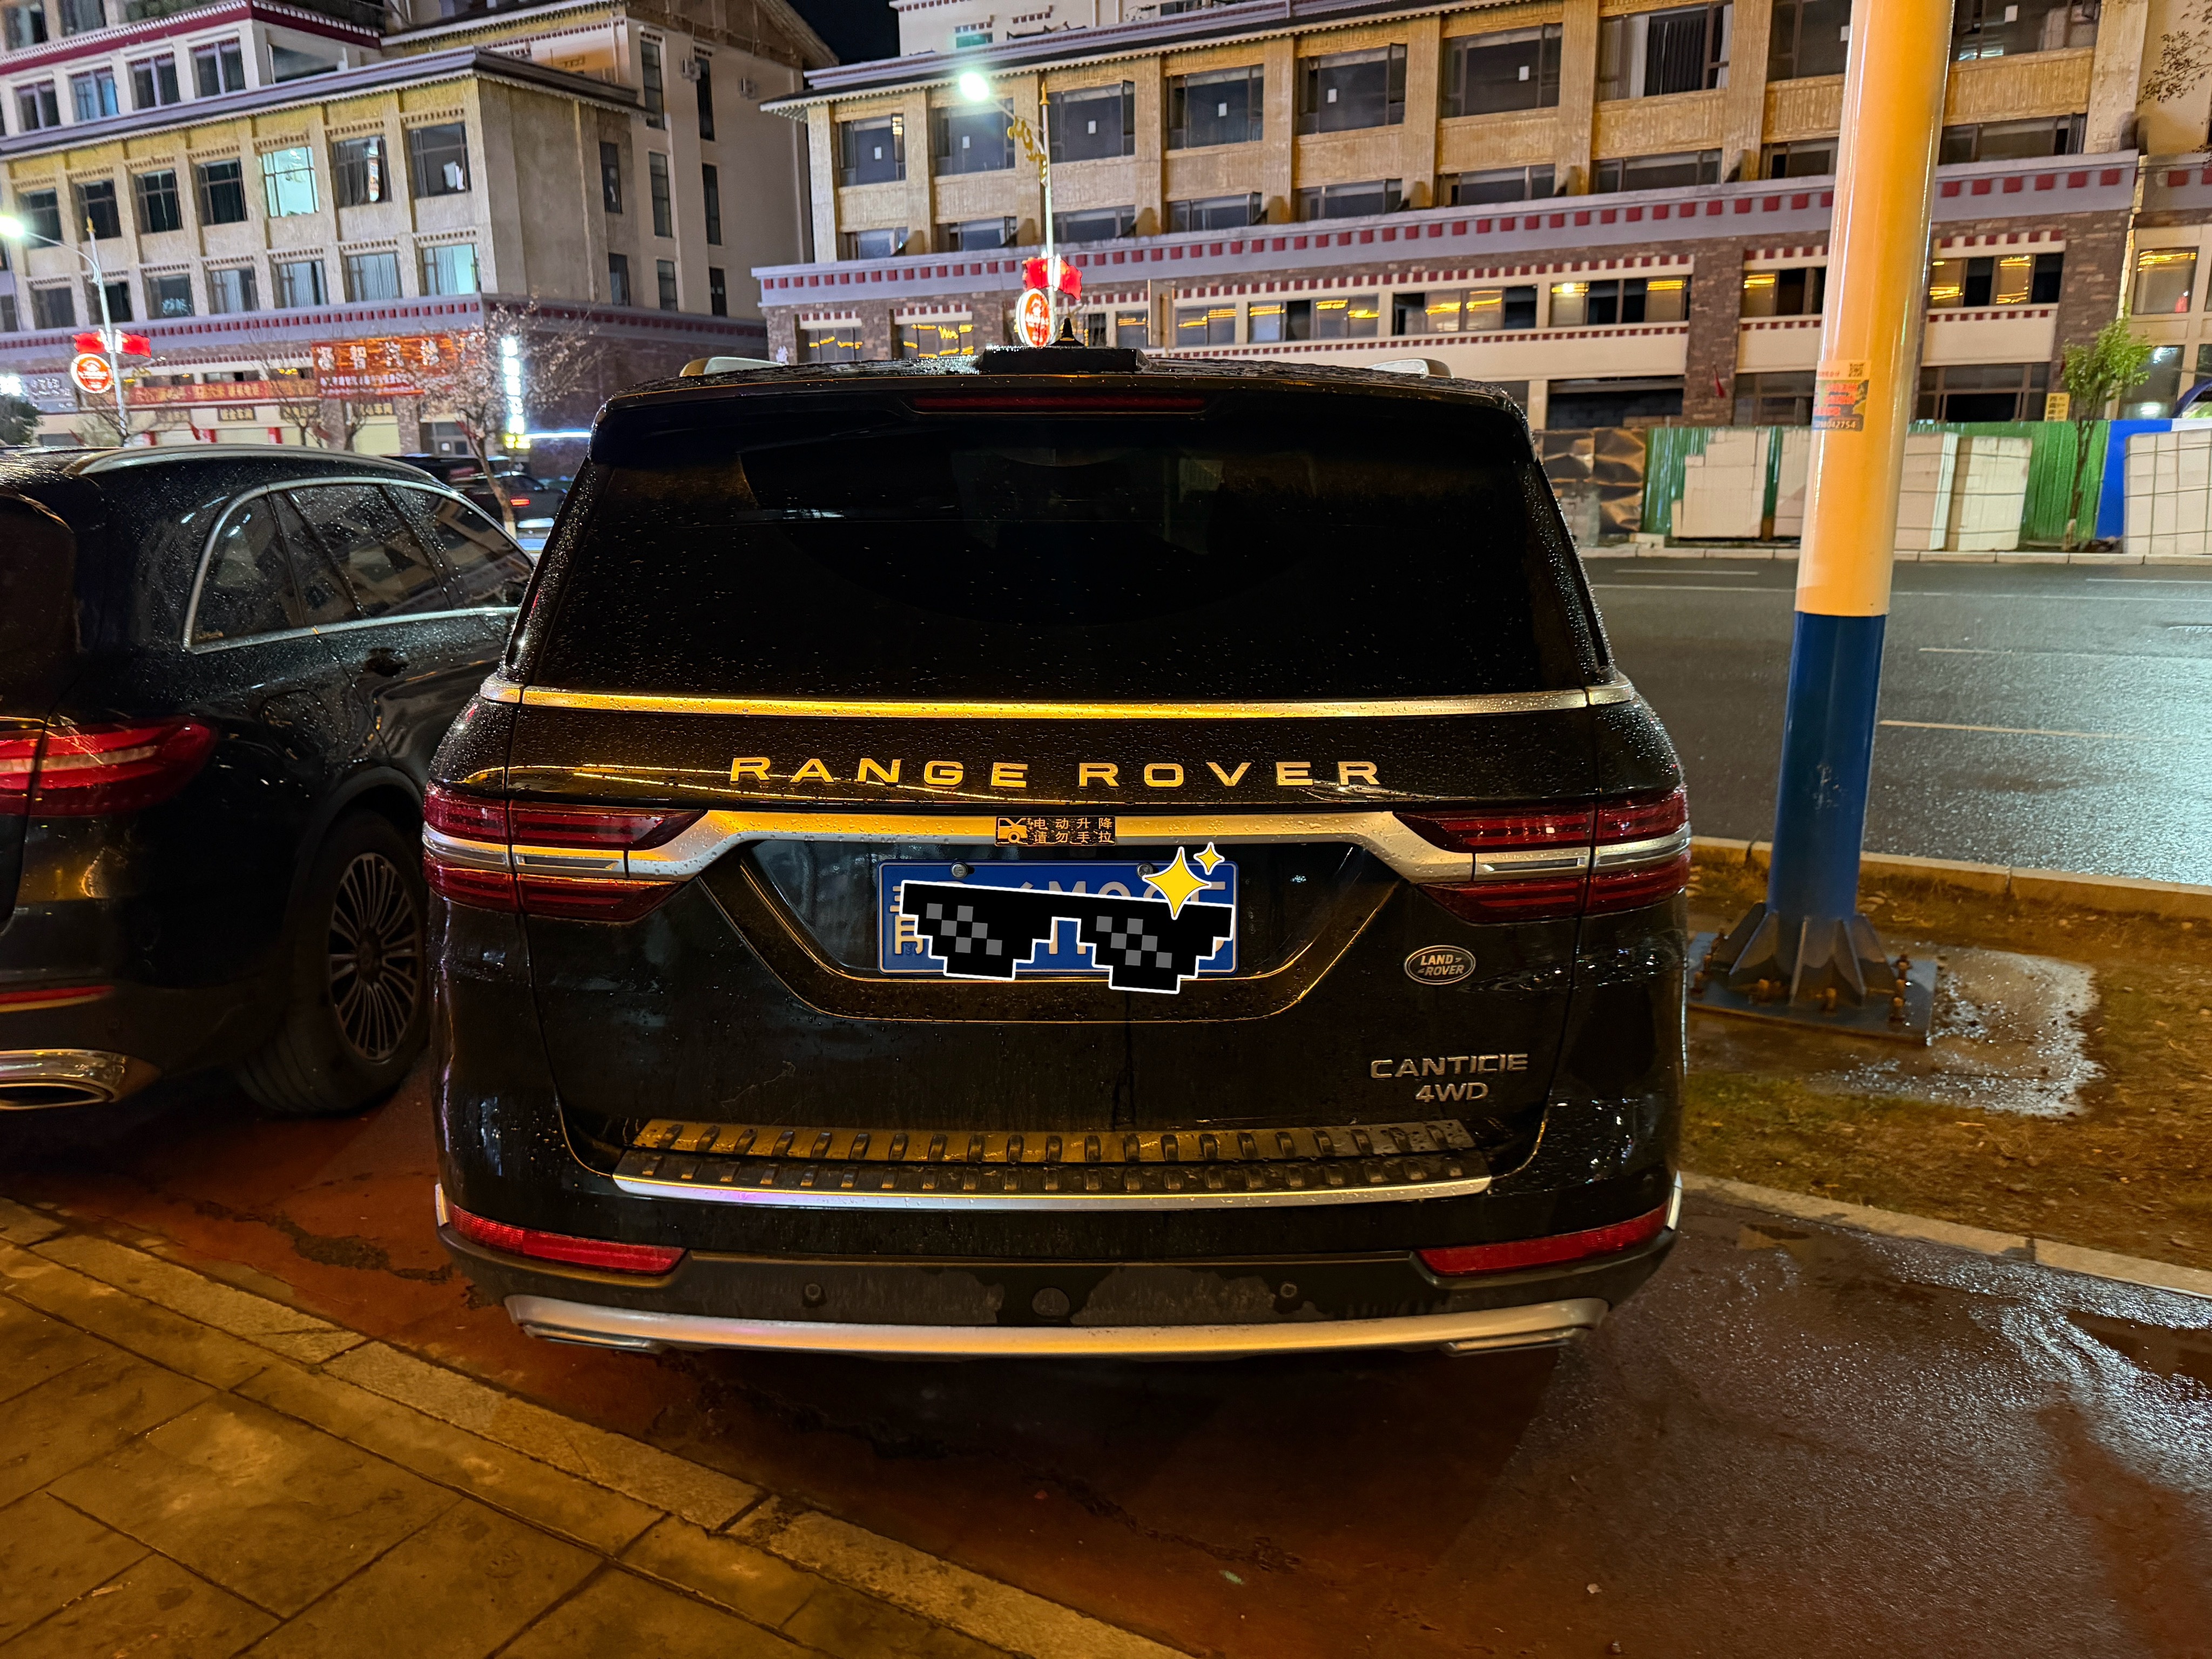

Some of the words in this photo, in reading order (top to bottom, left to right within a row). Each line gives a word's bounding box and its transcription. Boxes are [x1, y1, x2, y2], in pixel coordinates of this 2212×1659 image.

[729, 757, 1028, 788] RANGE
[1078, 762, 1379, 788] ROVER
[1034, 818, 1112, 830] 电动升降
[1034, 831, 1115, 844] 请勿手拉
[1420, 954, 1453, 966] LAND
[1424, 965, 1465, 976] ROVER
[1415, 1082, 1489, 1103] 4WD
